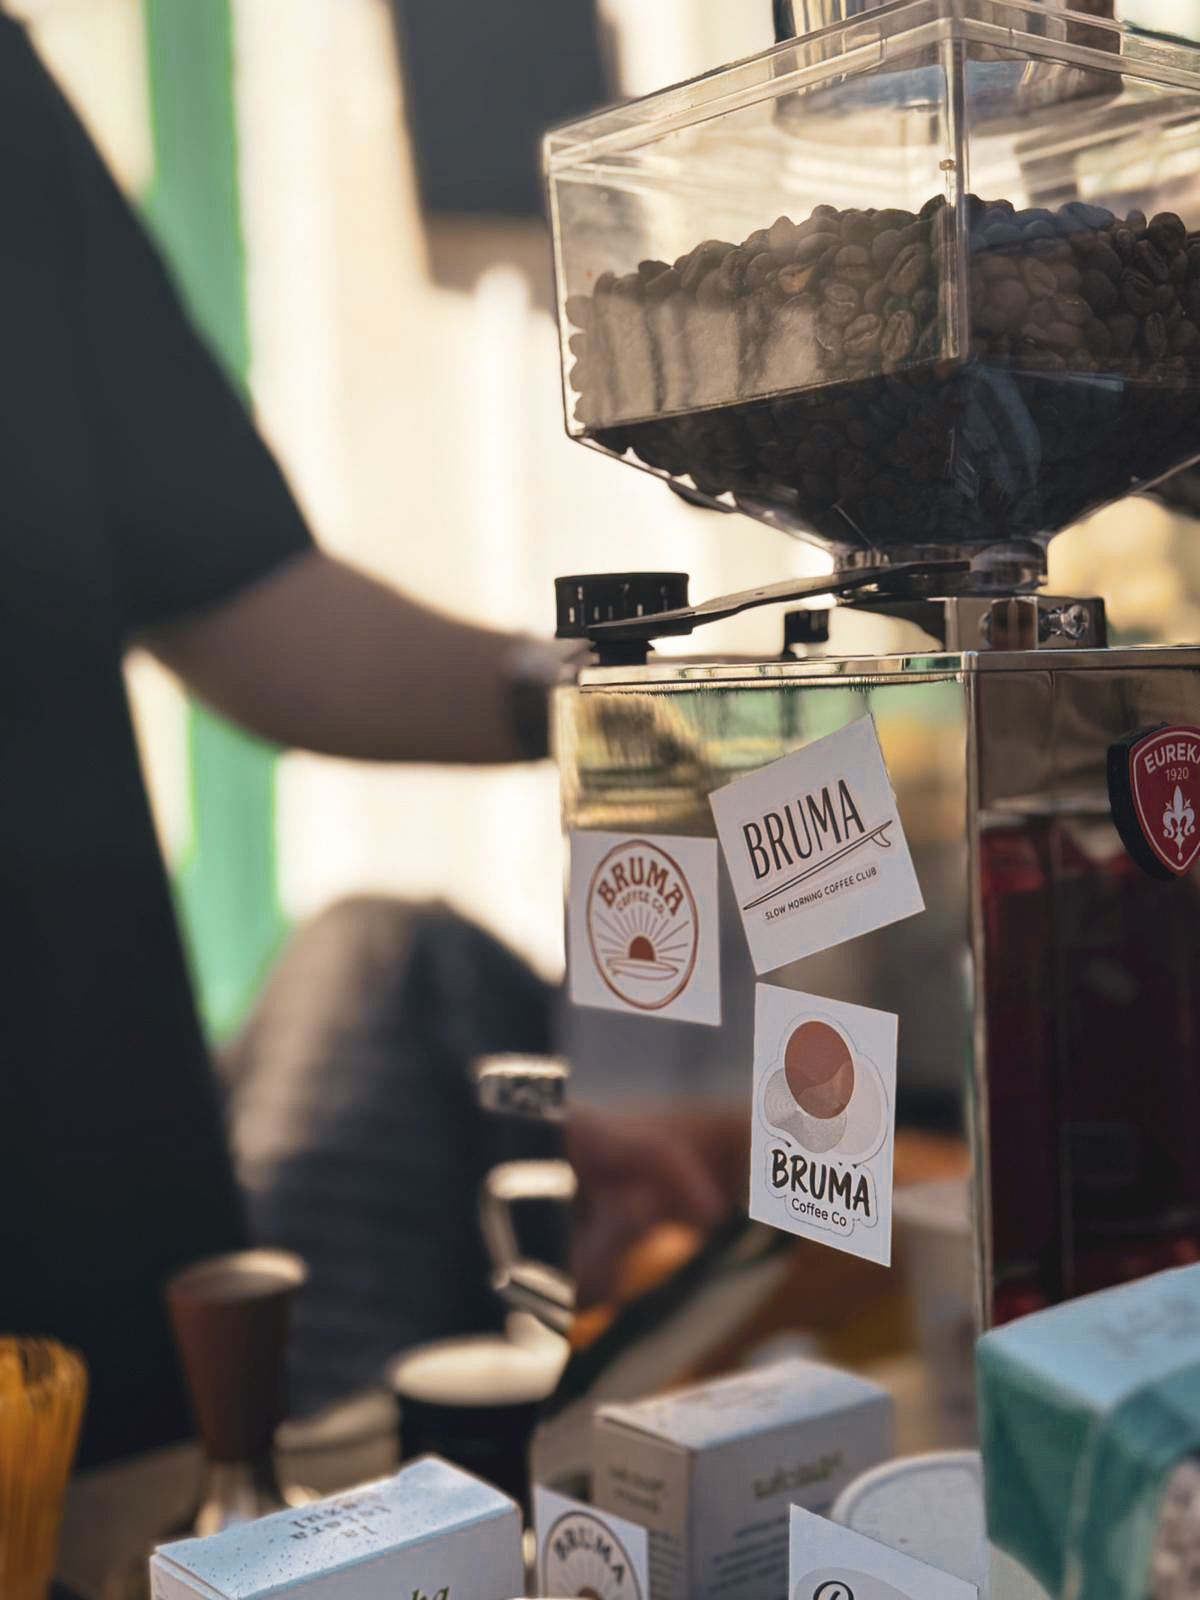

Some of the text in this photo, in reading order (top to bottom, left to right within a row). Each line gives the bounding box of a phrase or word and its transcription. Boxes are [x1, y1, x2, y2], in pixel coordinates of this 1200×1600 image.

[1165, 766, 1190, 782] 1920
[742, 779, 866, 880] BRUMA
[597, 856, 684, 916] BRUMA
[765, 866, 877, 920] SLOW MORNING COFFEE CLUB
[771, 1149, 870, 1217] BRUMA
[791, 1198, 847, 1227] Coffee Co
